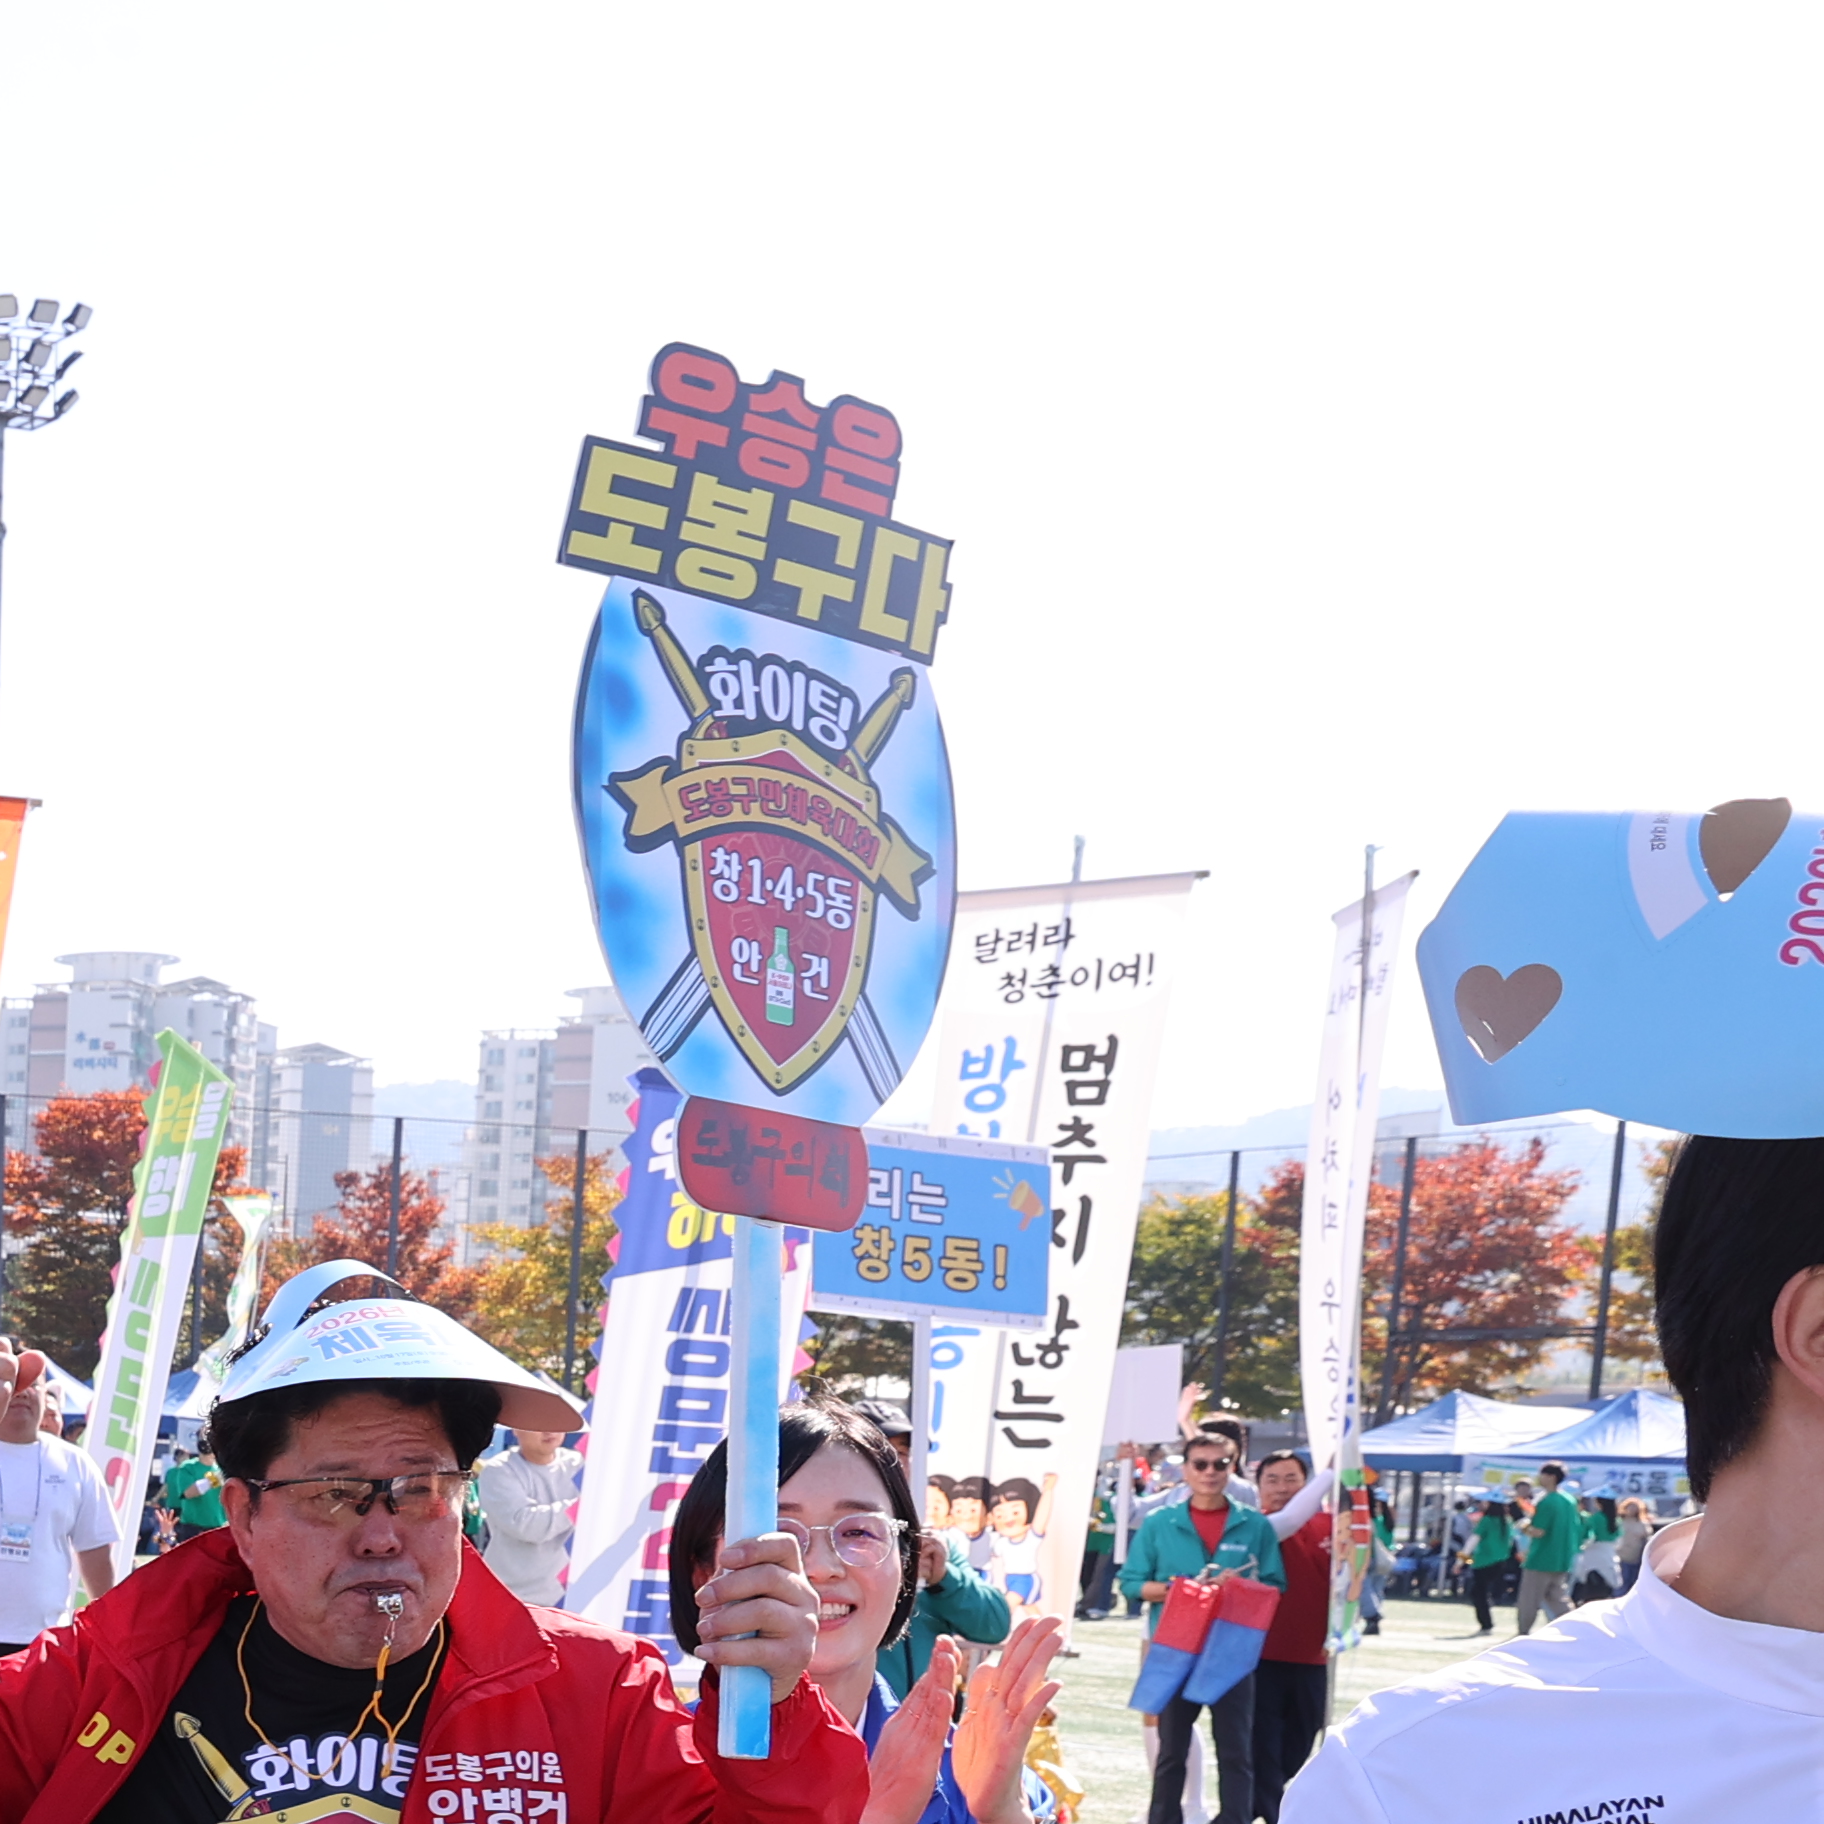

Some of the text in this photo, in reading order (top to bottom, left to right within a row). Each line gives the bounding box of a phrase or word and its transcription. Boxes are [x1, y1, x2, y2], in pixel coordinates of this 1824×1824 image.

[648, 351, 899, 517] 우승은
[564, 444, 949, 655] 도봉구다
[703, 656, 854, 752] 화이팅
[678, 776, 881, 870] 도봉구민체육대회
[730, 938, 763, 986] 안
[800, 953, 831, 1001] 건
[974, 919, 1076, 963] 달려라
[998, 951, 1155, 1005] 청춘이여!
[852, 1224, 1009, 1292] 창5동!
[312, 1321, 435, 1361] 체육
[425, 1750, 564, 1784] 도봉구의원
